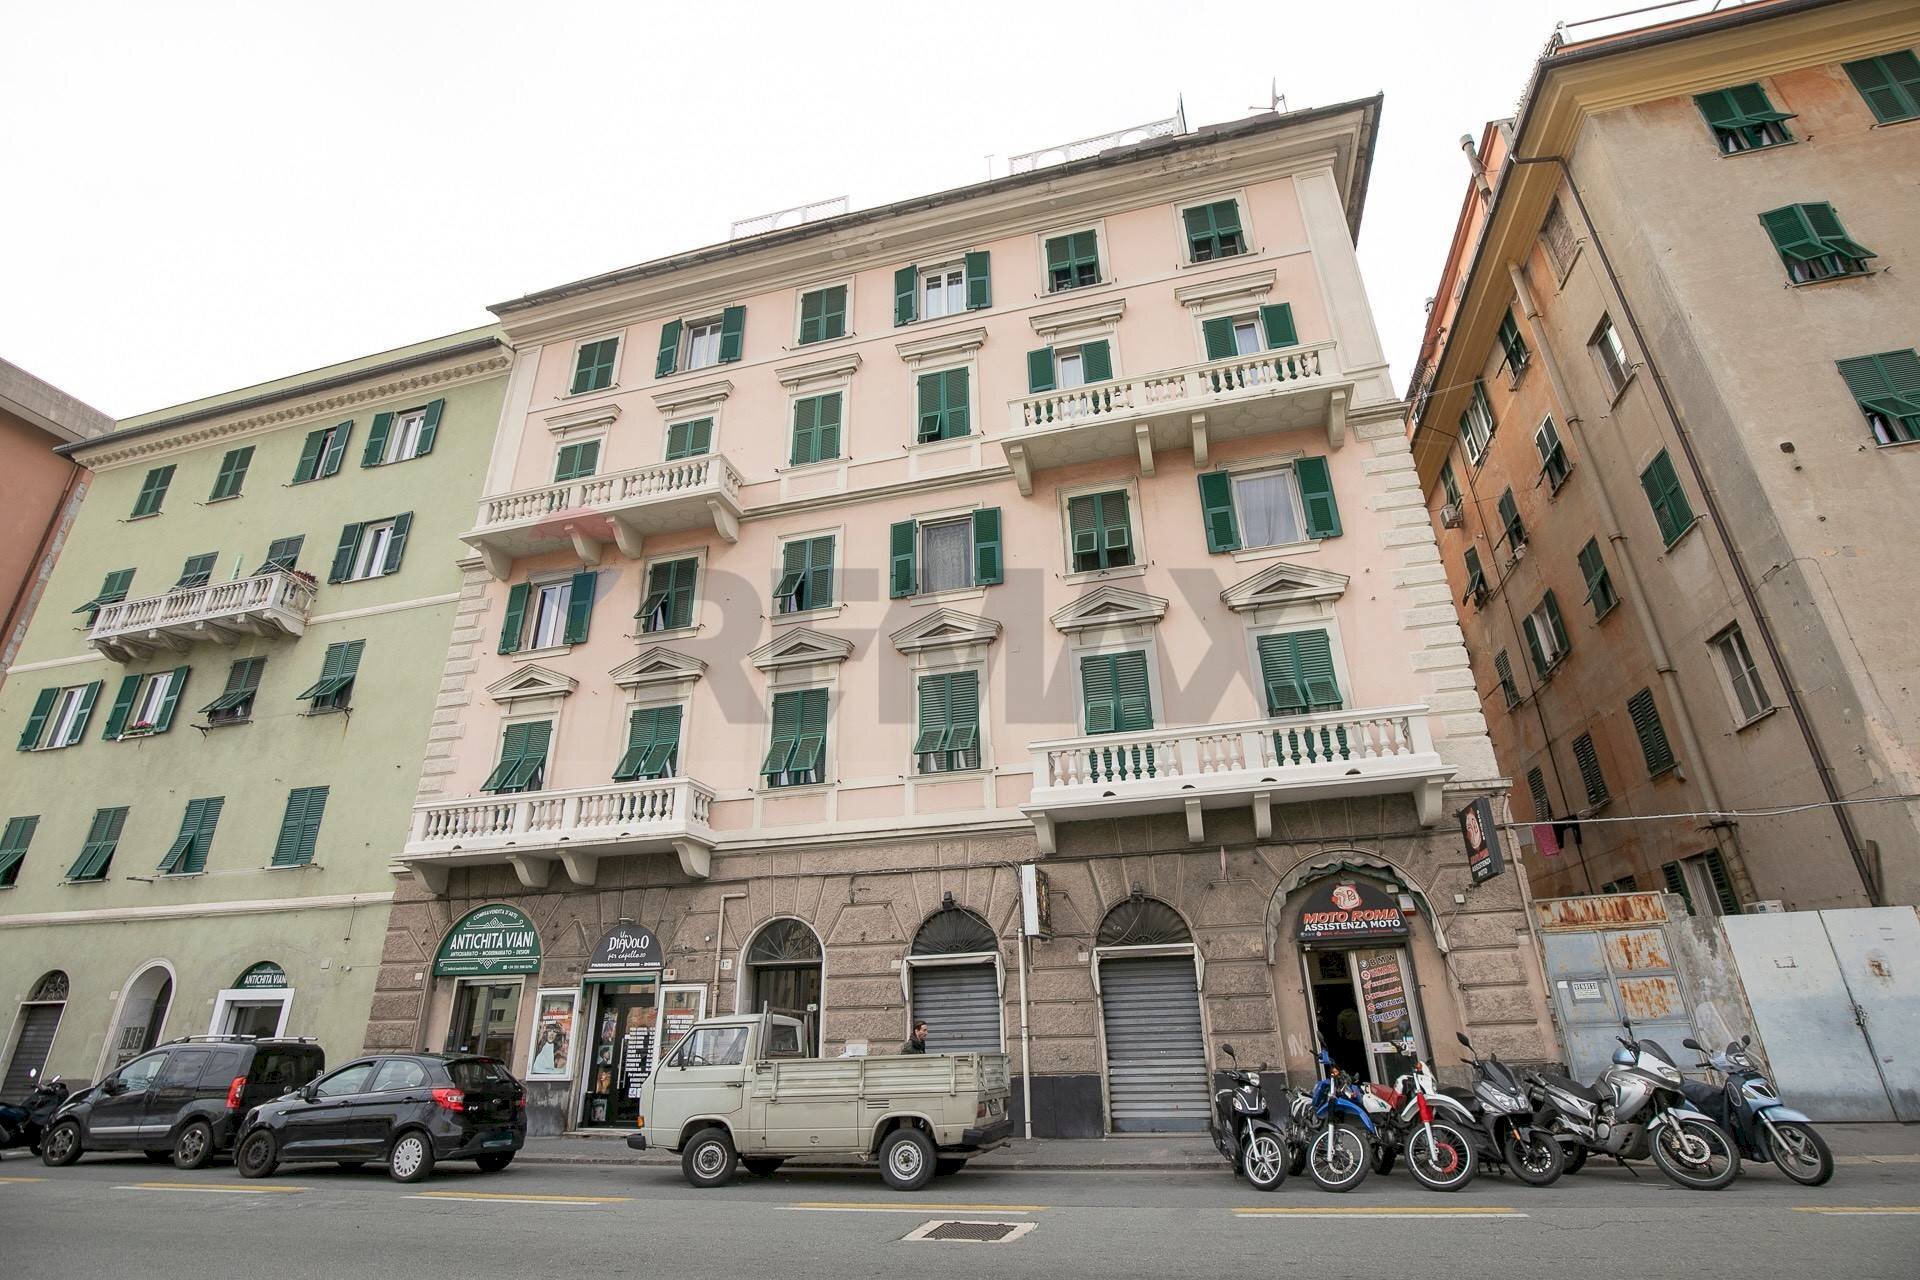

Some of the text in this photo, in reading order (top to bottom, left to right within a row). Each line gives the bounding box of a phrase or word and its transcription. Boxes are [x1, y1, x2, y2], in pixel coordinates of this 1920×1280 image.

[1303, 908, 1400, 924] MOTO ROMA
[1304, 919, 1401, 931] ASSISTENZA MOTO
[506, 931, 535, 948] VIANI
[606, 935, 650, 953] DIAVOLO
